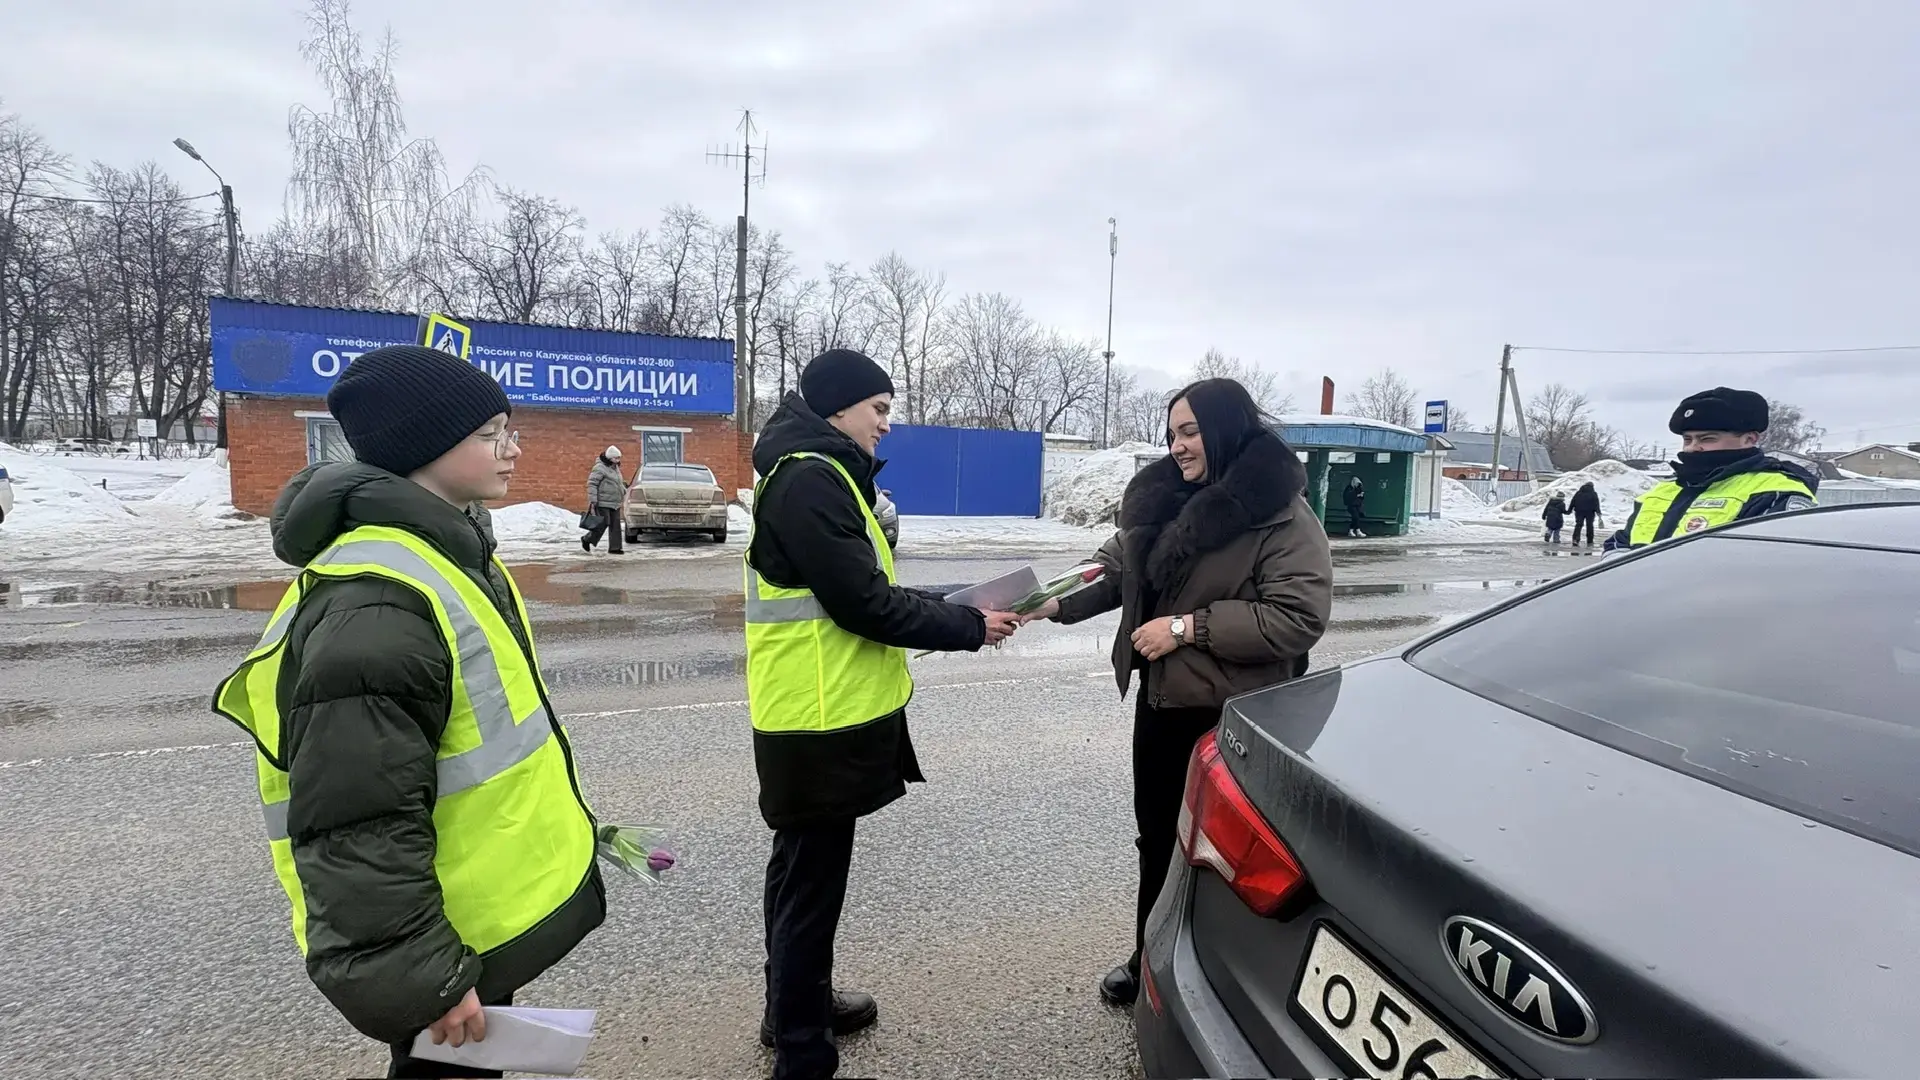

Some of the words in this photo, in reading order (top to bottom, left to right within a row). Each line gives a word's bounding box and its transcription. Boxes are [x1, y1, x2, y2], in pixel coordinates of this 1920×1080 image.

[326, 338, 381, 349] телефон
[476, 345, 516, 357] России
[520, 350, 533, 358] по
[535, 350, 592, 362] Калужской
[595, 354, 636, 366] области
[638, 357, 675, 368] 502-800
[548, 364, 698, 399] ПОЛИЦИИ
[1458, 925, 1559, 1034] KIA
